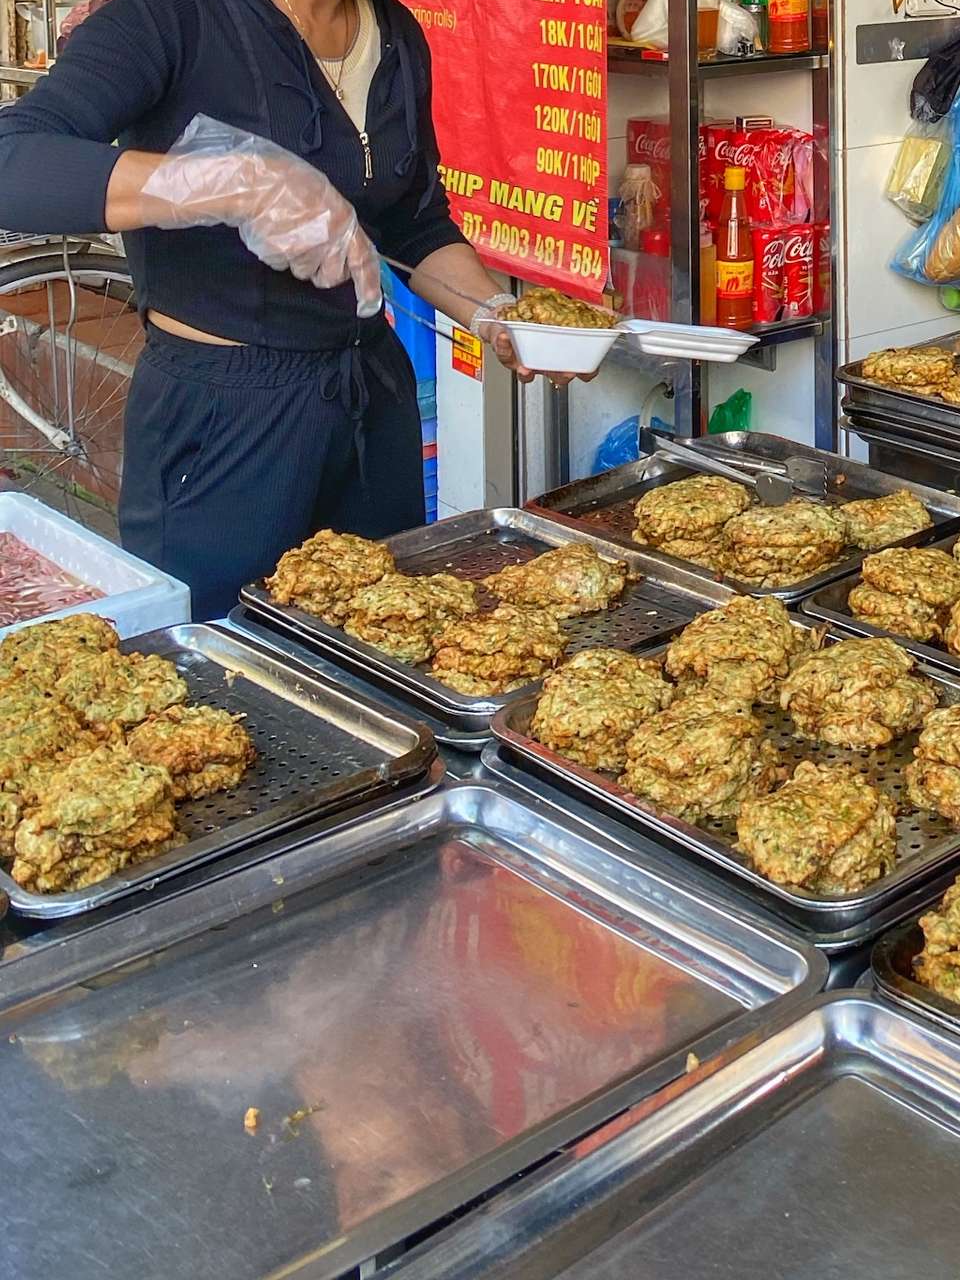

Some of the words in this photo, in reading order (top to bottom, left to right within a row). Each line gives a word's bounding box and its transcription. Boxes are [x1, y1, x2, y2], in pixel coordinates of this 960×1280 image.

[489, 179, 564, 222] MANG
[572, 195, 599, 233] VỀ
[489, 220, 530, 259] 0903
[534, 233, 565, 269] 481
[570, 243, 602, 281] 584
